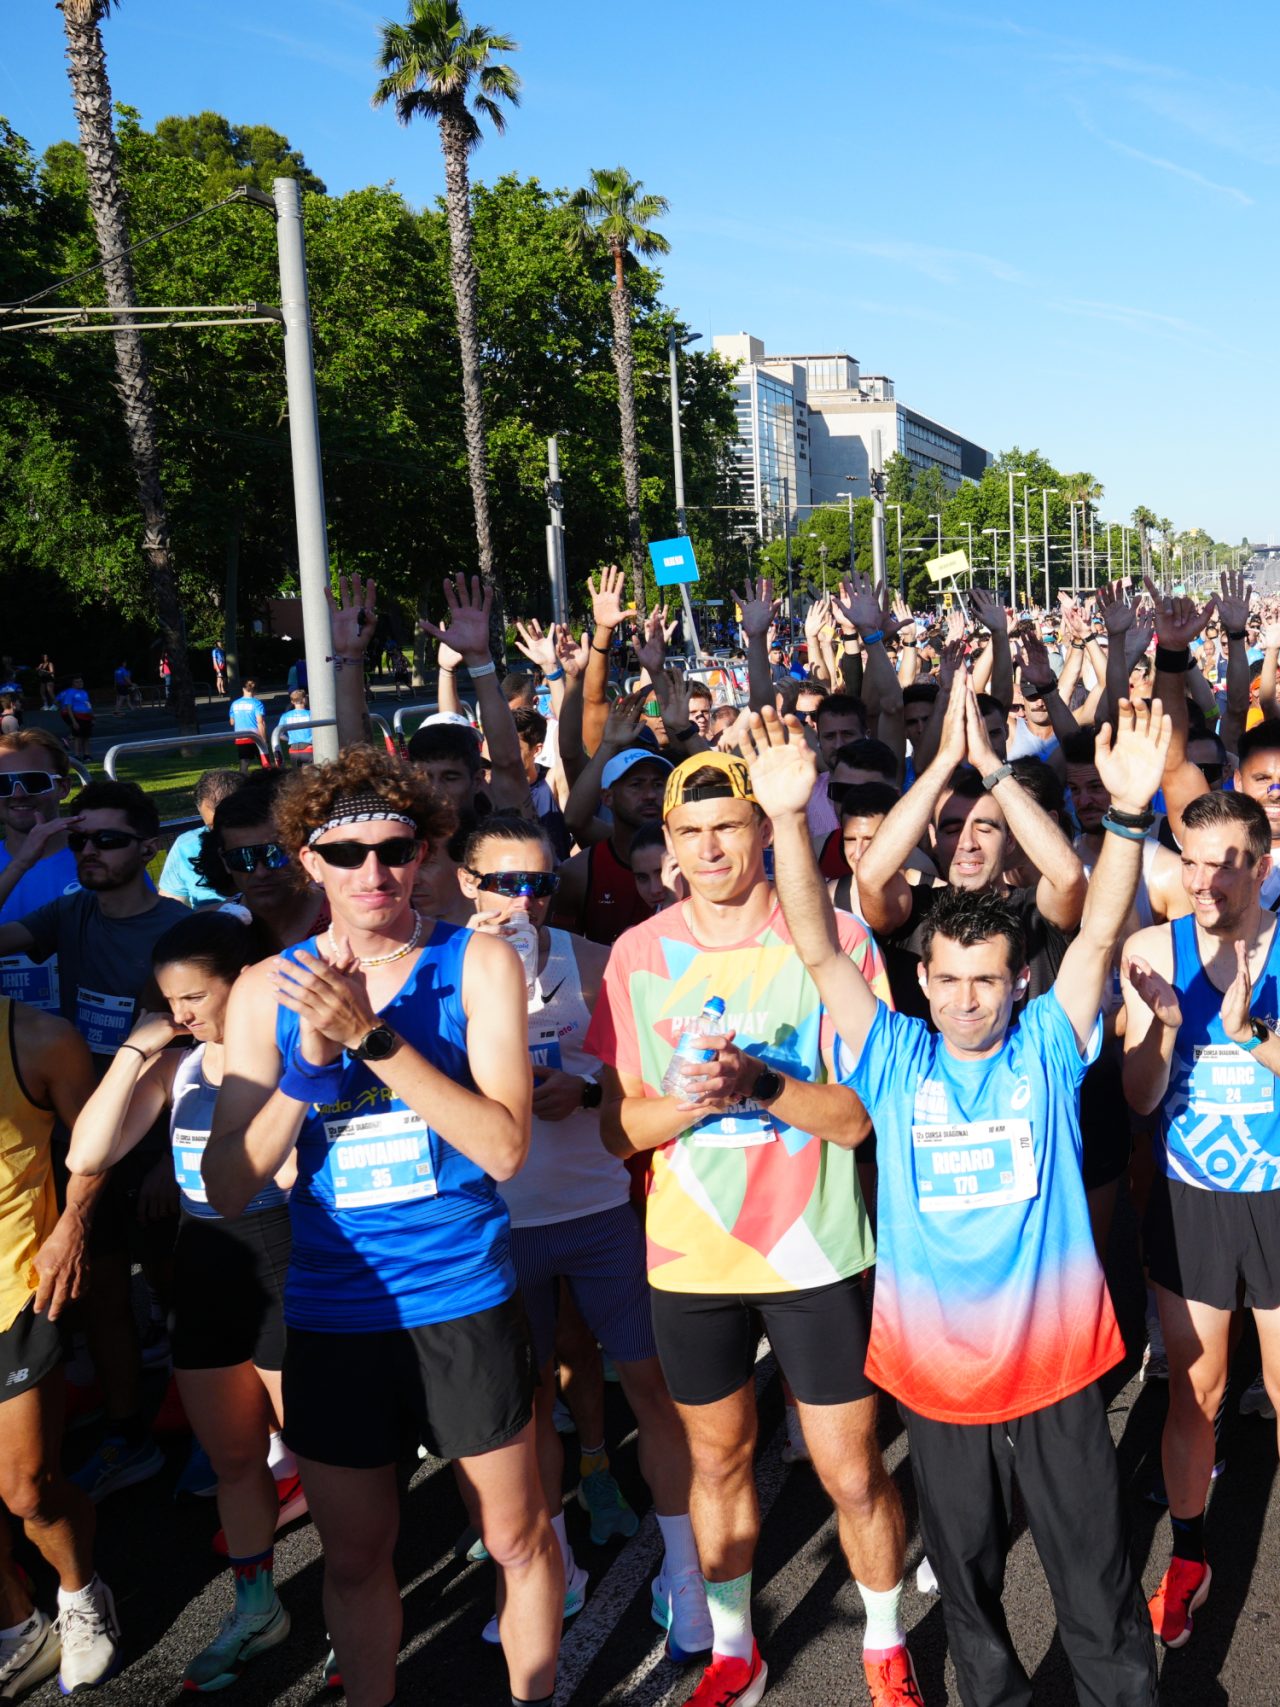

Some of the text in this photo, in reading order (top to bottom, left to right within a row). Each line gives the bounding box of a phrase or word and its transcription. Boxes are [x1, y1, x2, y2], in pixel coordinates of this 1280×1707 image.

[1212, 1066, 1255, 1086] MARC
[1226, 1087, 1241, 1104] 24
[336, 1137, 420, 1170] GIOVANNI
[931, 1147, 995, 1175] RICARD
[370, 1167, 393, 1188] 35
[953, 1174, 978, 1195] 170
